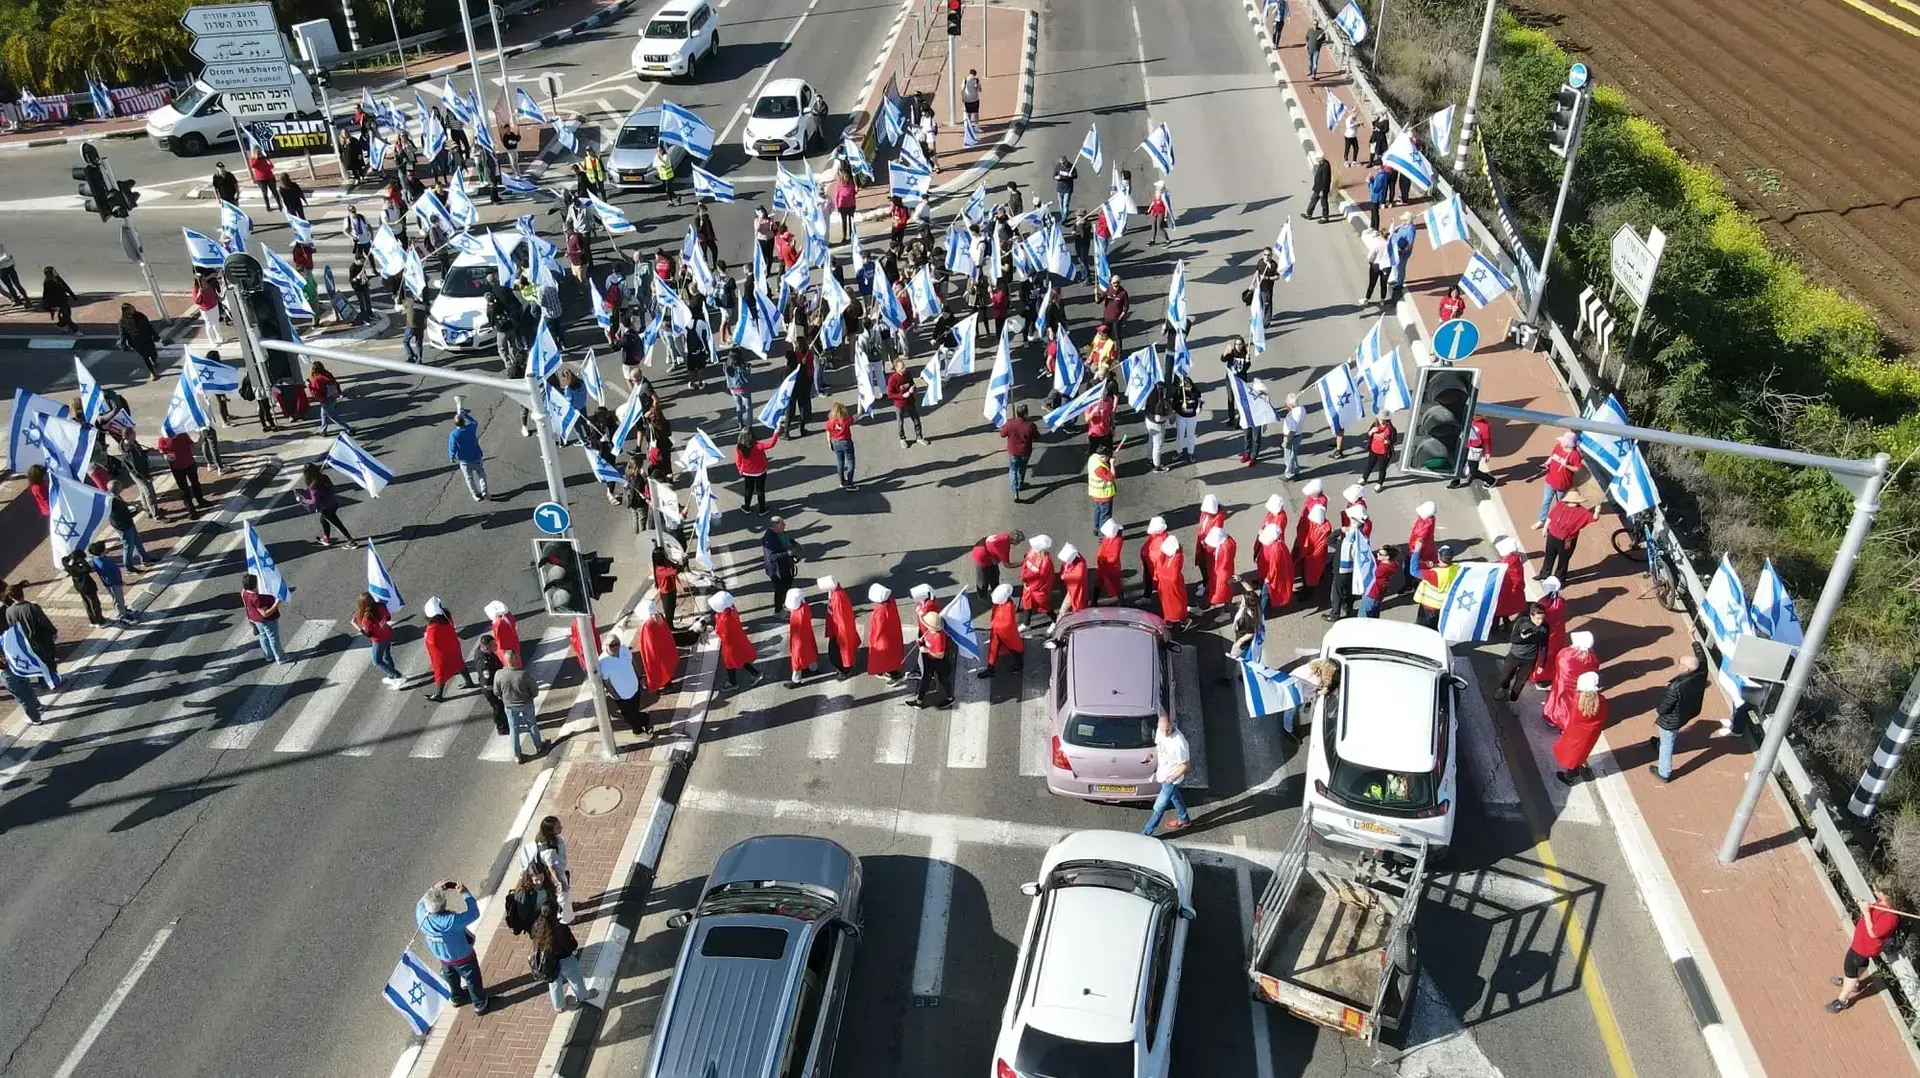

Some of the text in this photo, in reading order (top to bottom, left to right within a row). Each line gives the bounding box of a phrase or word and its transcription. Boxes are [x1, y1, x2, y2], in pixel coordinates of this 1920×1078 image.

[204, 19, 259, 31] דרום השרון
[209, 65, 283, 76] Drom HaSharon
[215, 78, 248, 86] Regional
[230, 89, 291, 101] היכל התרבות
[239, 101, 288, 114] דרום השרון
[270, 120, 326, 134] חובה
[274, 132, 328, 148] להתנגד
